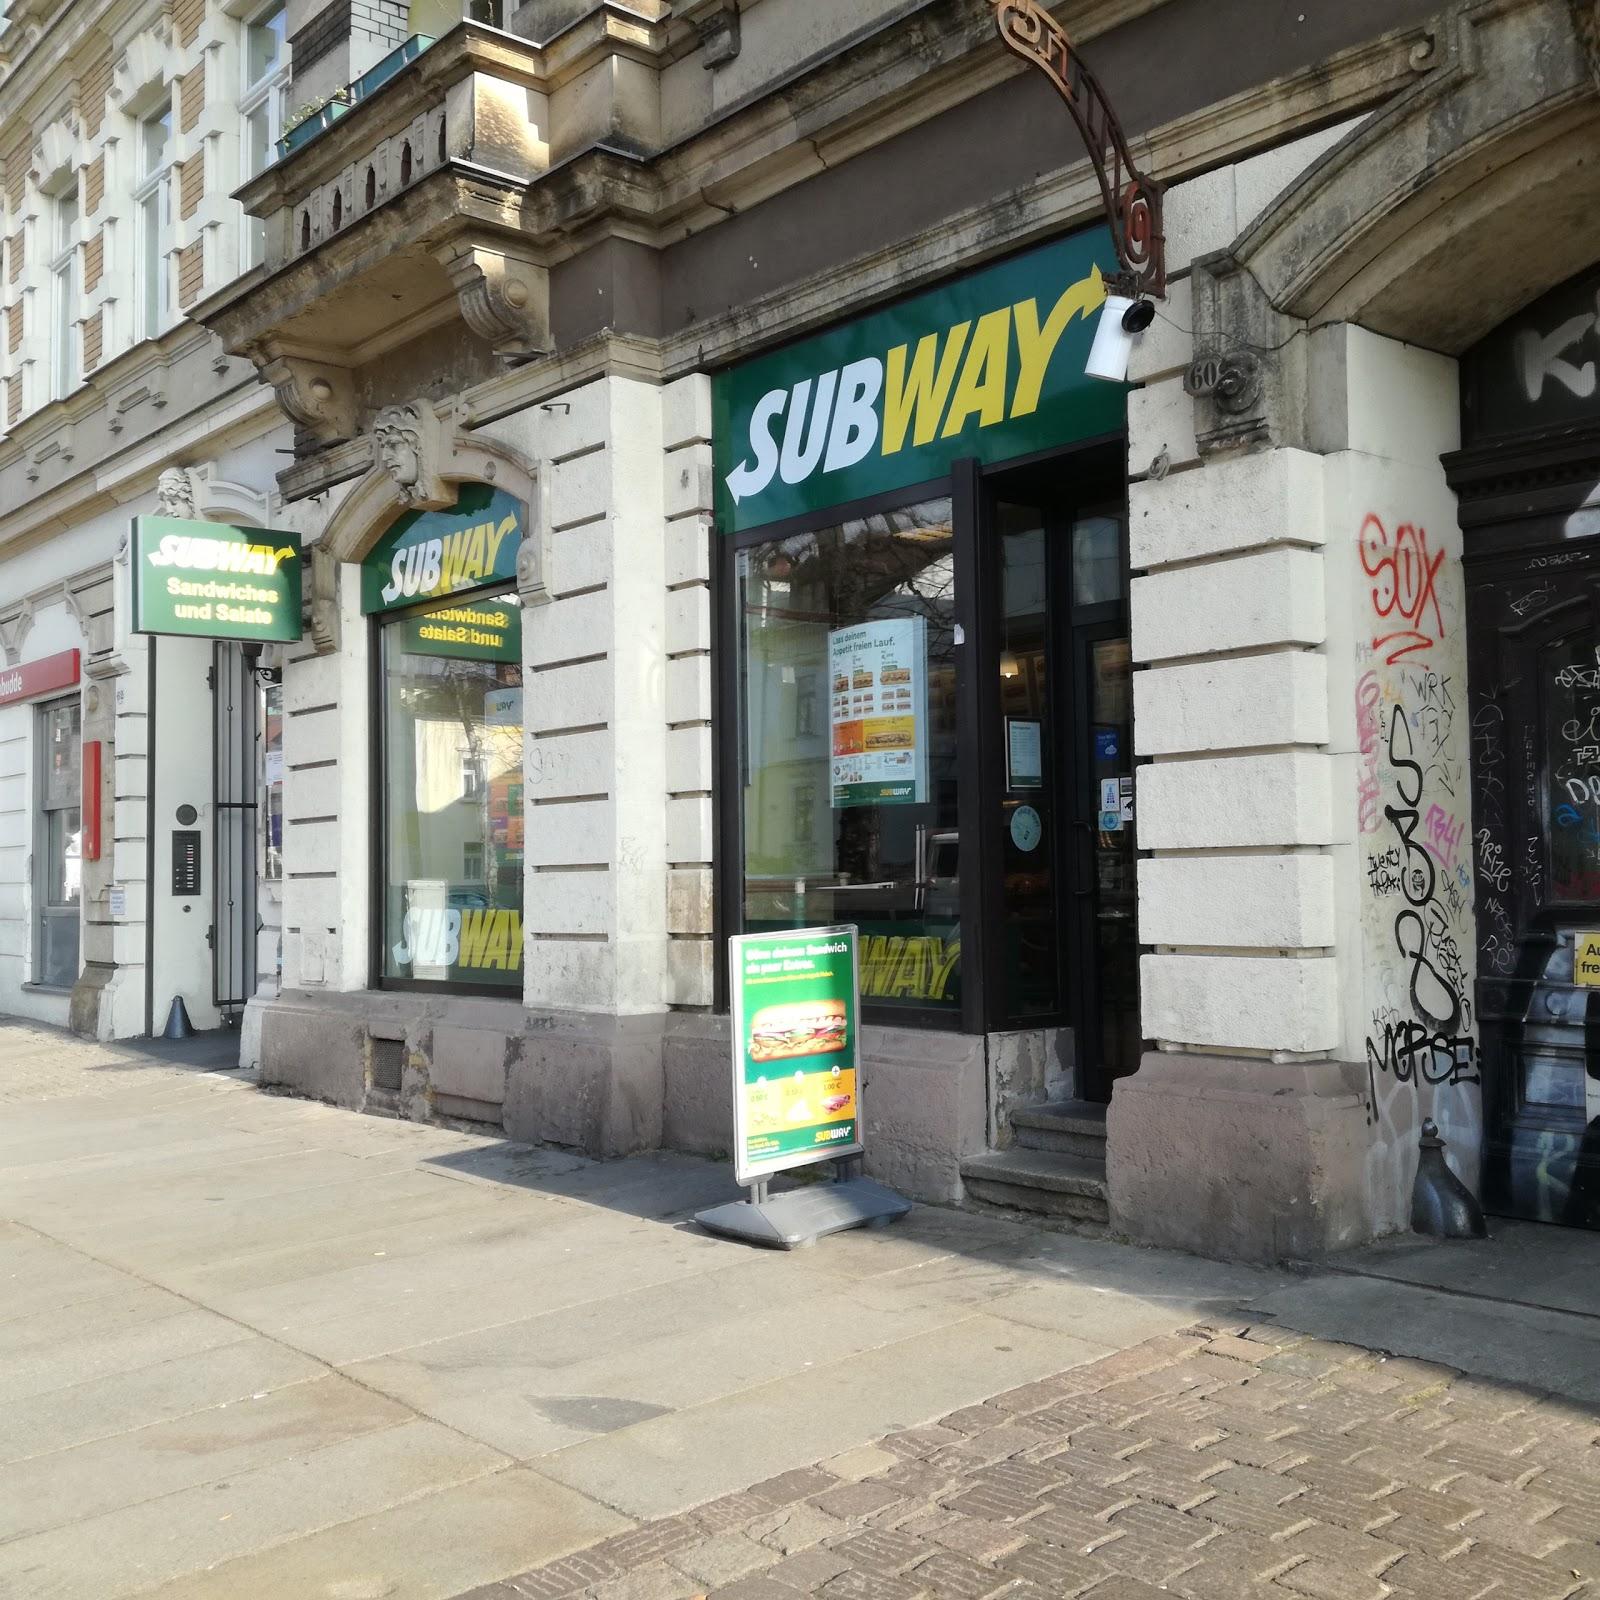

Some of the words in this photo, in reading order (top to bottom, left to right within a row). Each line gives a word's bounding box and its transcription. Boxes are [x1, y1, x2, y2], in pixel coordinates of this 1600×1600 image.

[725, 262, 1107, 506] SUBWAY
[1190, 361, 1217, 390] 60
[147, 534, 296, 576] SUBWAY
[381, 510, 518, 607] SUBWAY
[166, 576, 279, 603] Sandwiches
[175, 603, 212, 620] und
[215, 603, 272, 625] Salate
[874, 636, 896, 648] Lauf.
[392, 907, 523, 970] SUBWAY
[815, 1126, 852, 1143] SUBWAY
